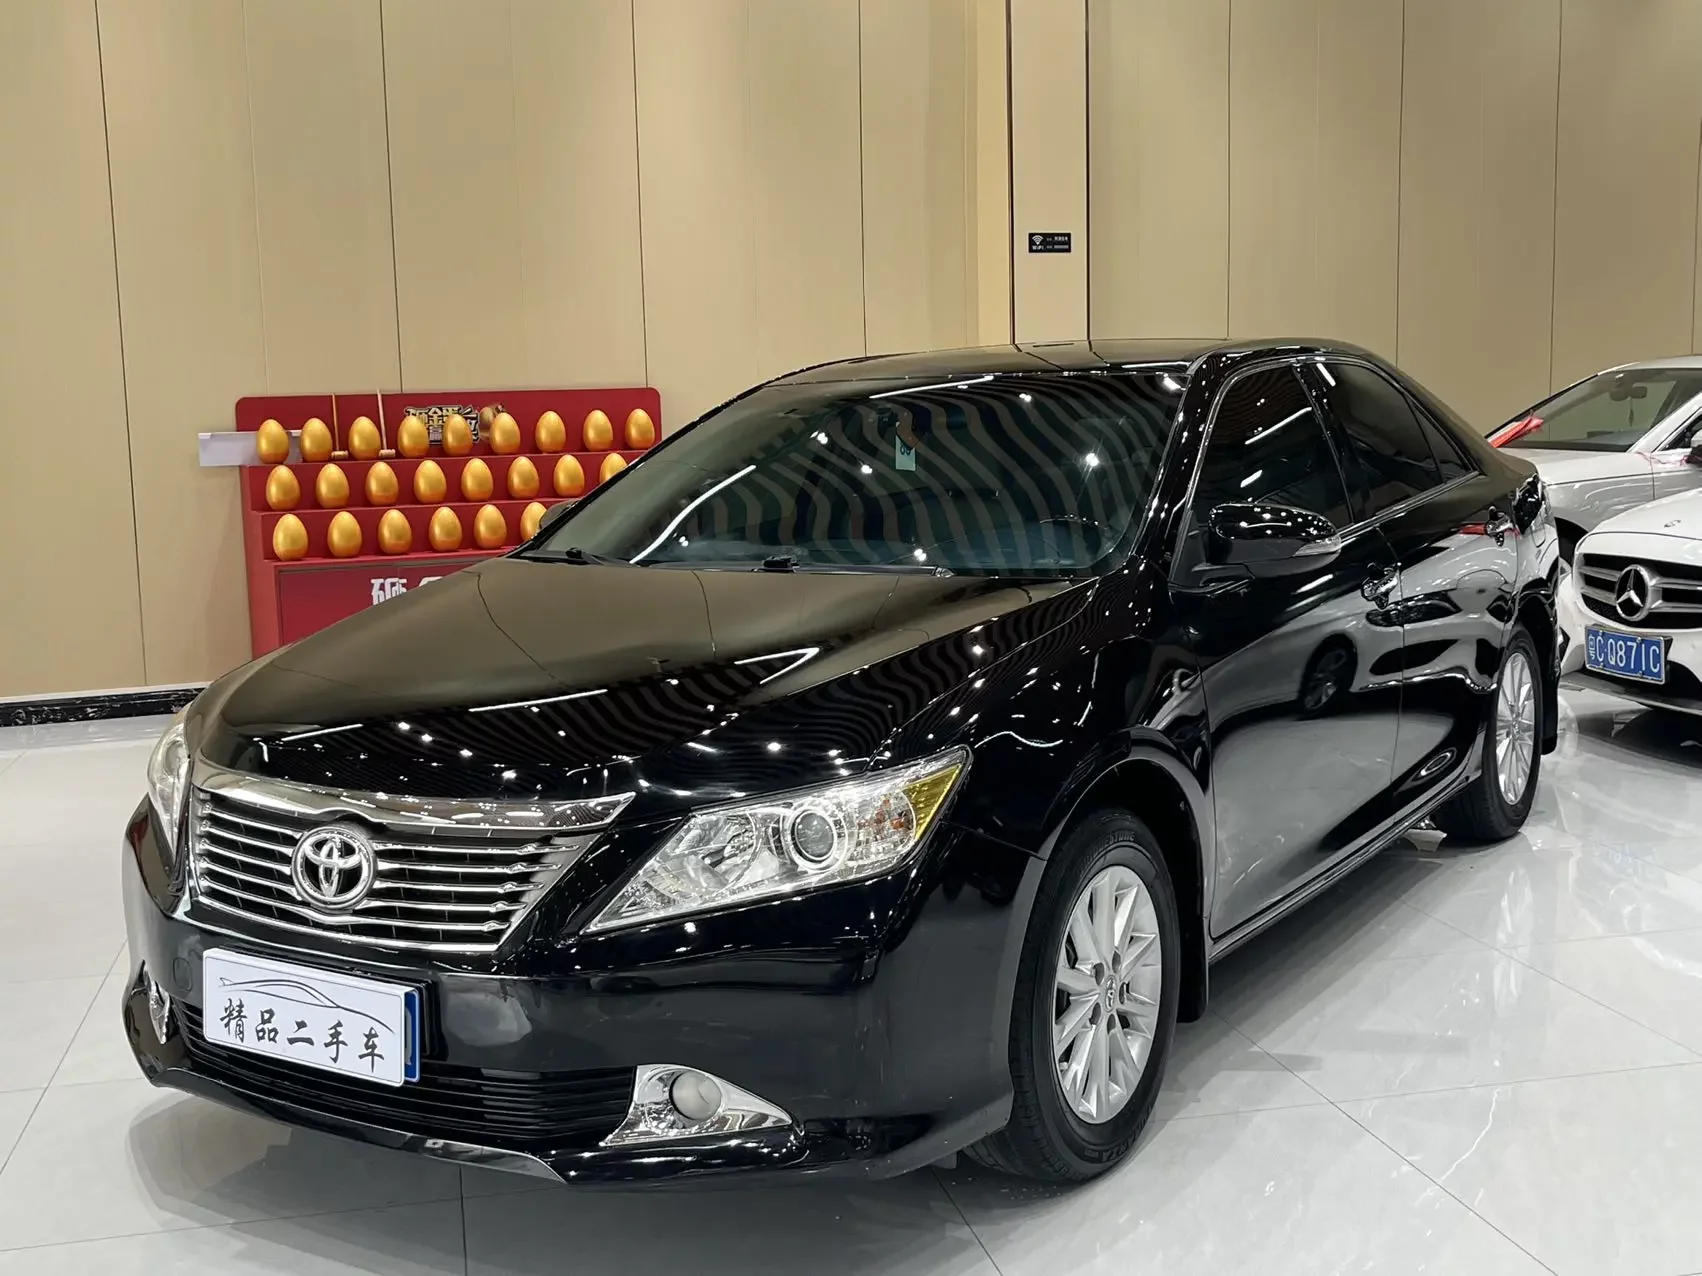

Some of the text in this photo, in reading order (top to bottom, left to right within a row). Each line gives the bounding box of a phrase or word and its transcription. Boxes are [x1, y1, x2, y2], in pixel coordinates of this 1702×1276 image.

[219, 997, 385, 1073] 精品二手车
